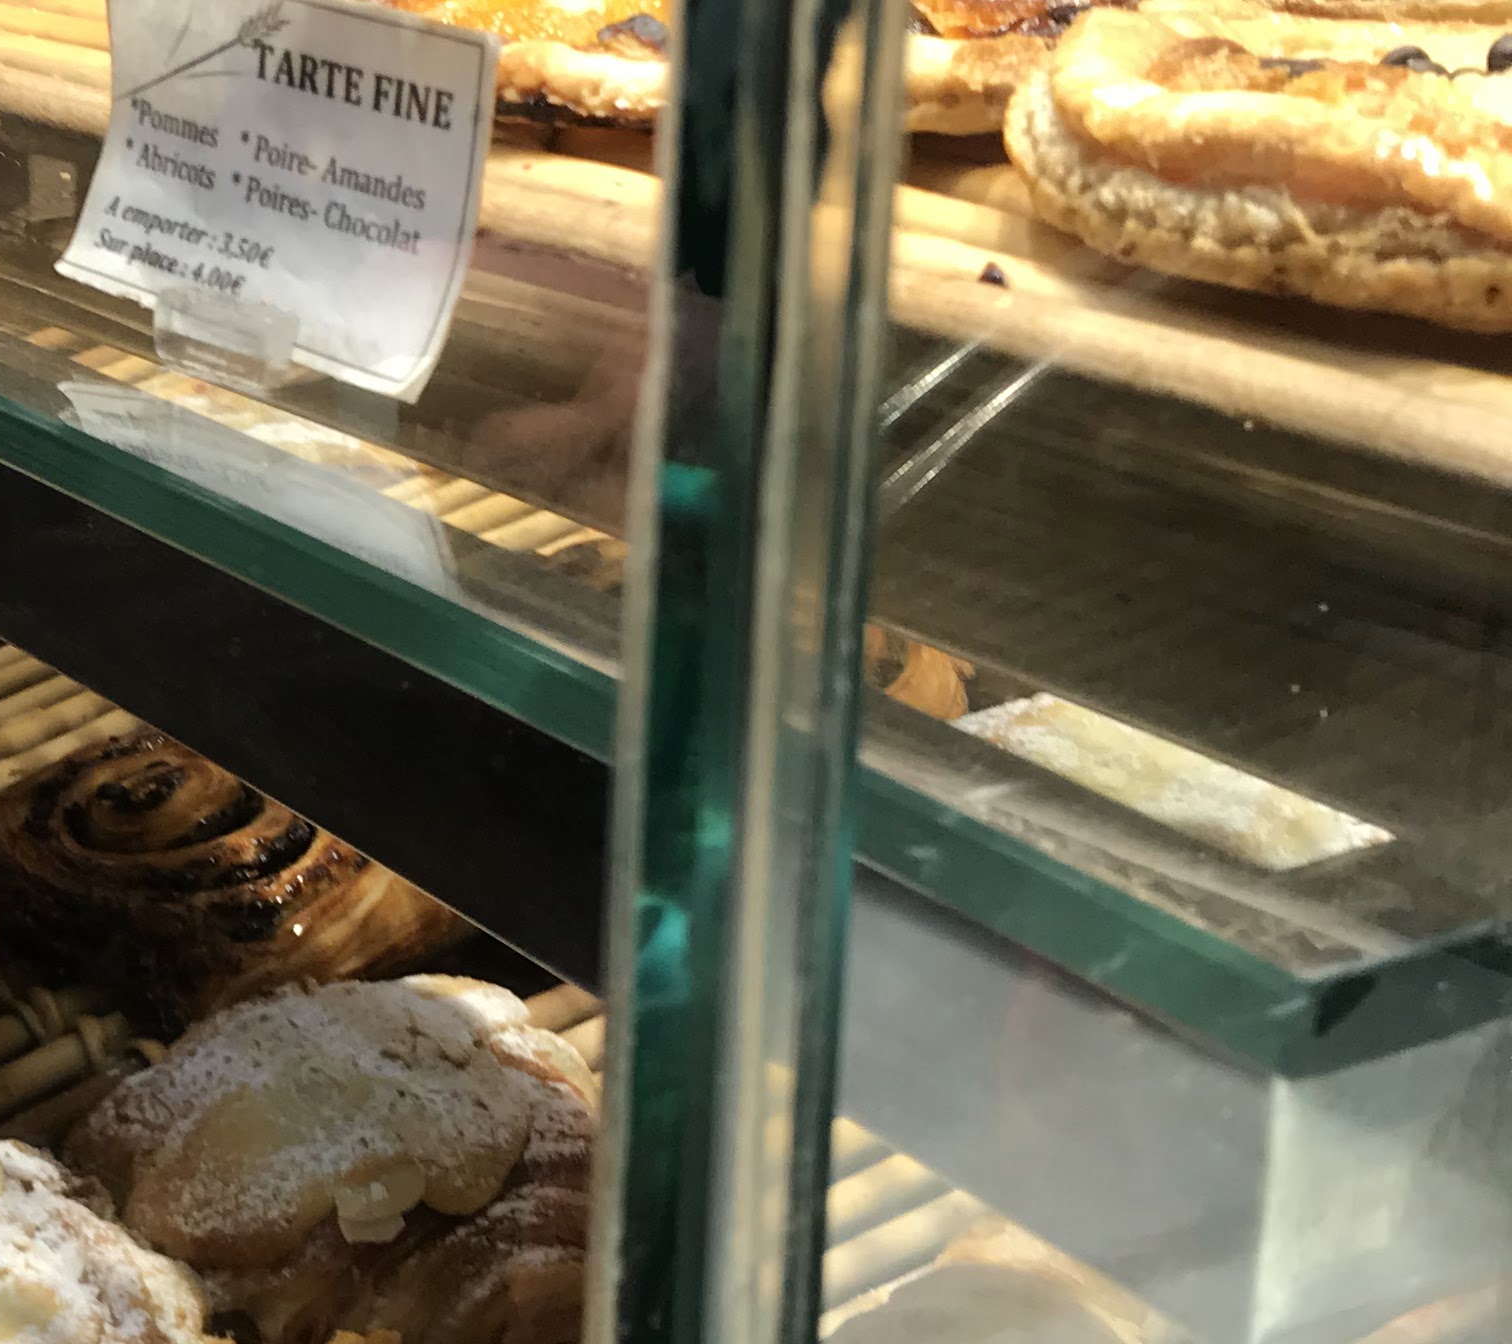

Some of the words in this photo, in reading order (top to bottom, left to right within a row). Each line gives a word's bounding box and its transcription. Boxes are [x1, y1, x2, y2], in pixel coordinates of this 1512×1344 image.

[252, 38, 364, 107] TARTE
[372, 71, 455, 131] FINE
[135, 142, 217, 190] Abricots
[323, 199, 422, 256] Chocolat
[320, 156, 427, 210] Amandes
